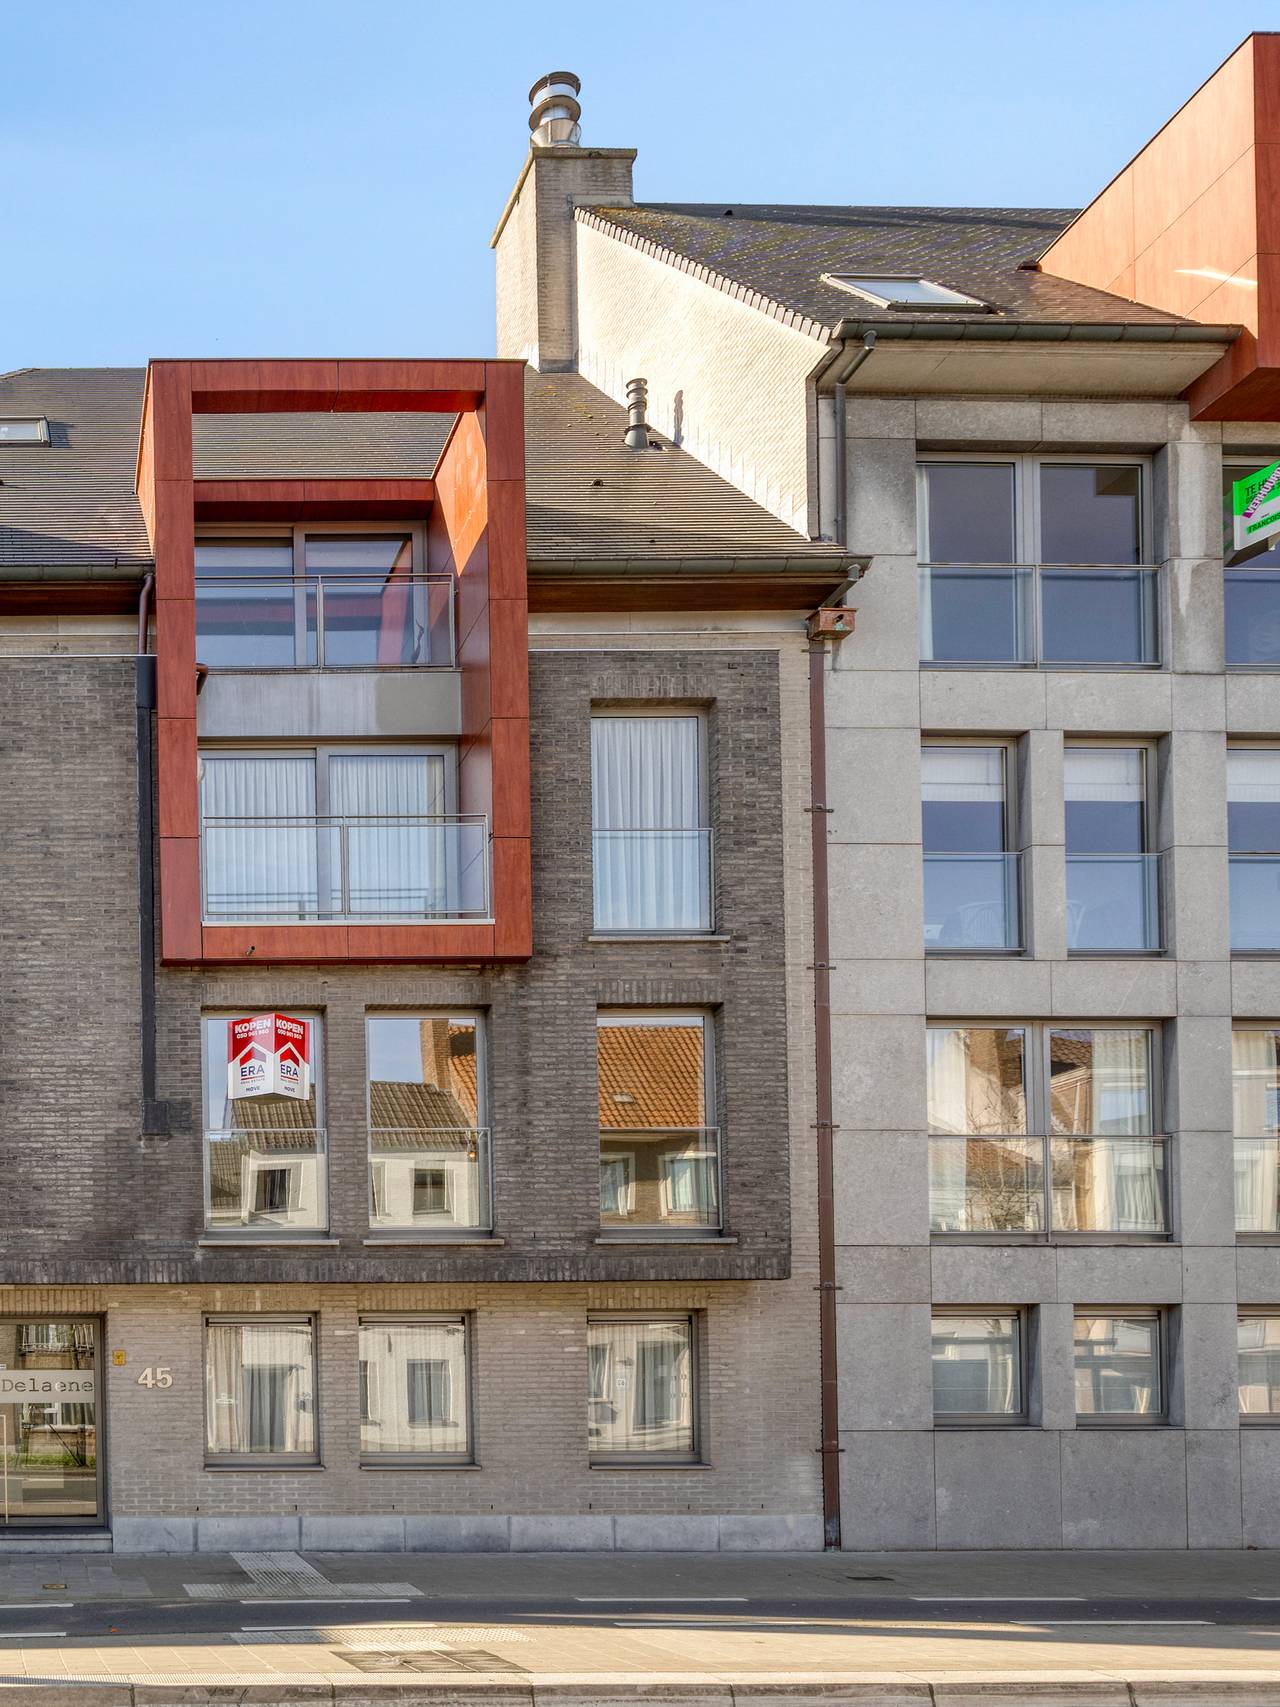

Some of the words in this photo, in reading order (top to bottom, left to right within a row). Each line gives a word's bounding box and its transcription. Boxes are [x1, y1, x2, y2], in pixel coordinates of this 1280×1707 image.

[1245, 484, 1257, 497] TE
[235, 1018, 271, 1034] KOPEN
[276, 1018, 304, 1035] KOPEN
[240, 1064, 265, 1077] ERA
[280, 1064, 299, 1077] ERA
[1, 1377, 94, 1392] Delaene
[137, 1367, 173, 1389] 45
